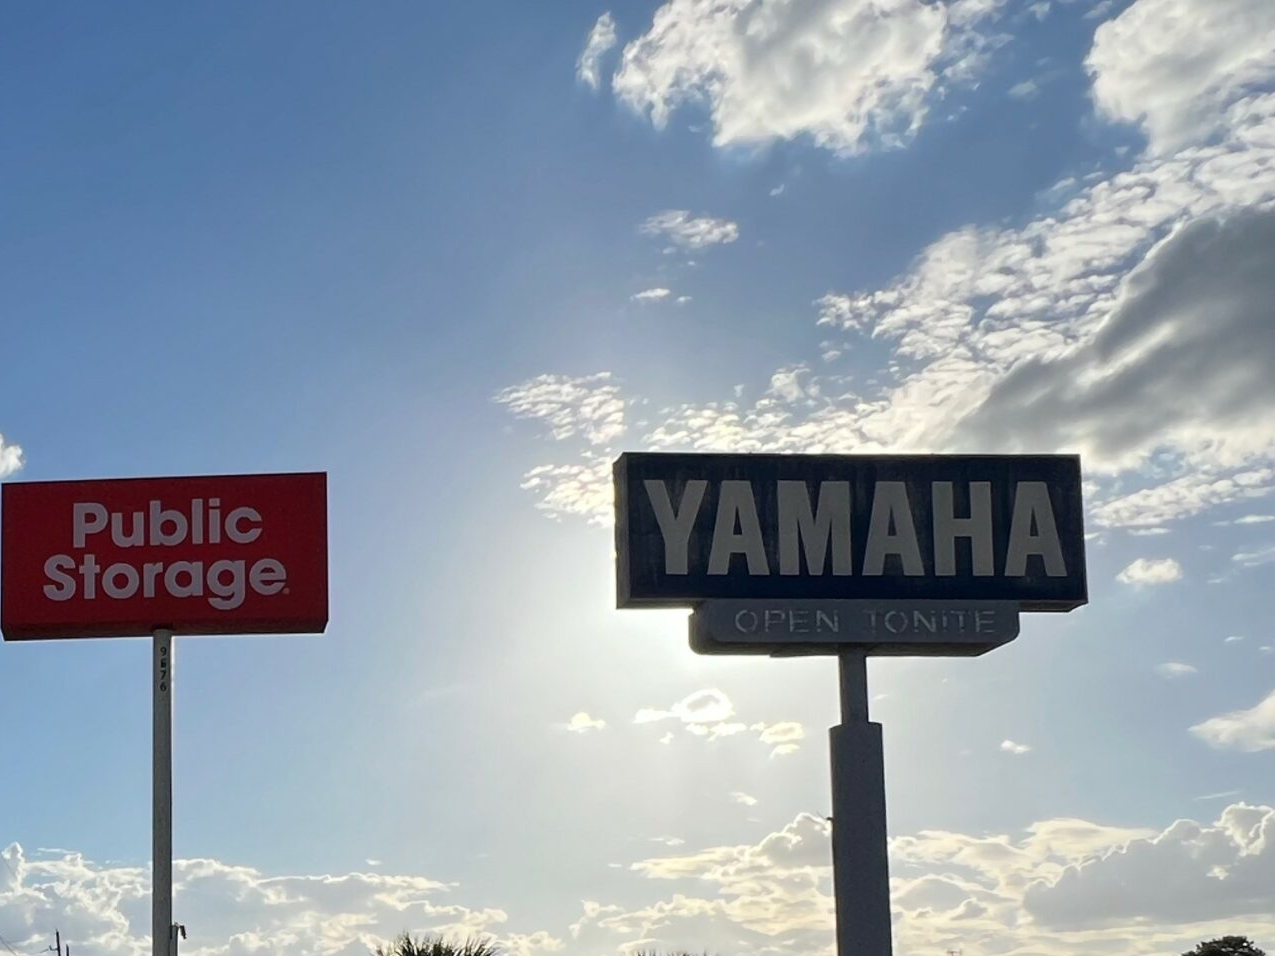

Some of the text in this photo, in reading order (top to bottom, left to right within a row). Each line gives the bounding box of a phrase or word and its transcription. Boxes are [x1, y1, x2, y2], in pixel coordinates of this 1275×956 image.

[72, 497, 263, 548] Public
[644, 480, 1067, 577] YAMAHA
[43, 554, 287, 610] Storage
[735, 609, 996, 635] OPEN TONITE
